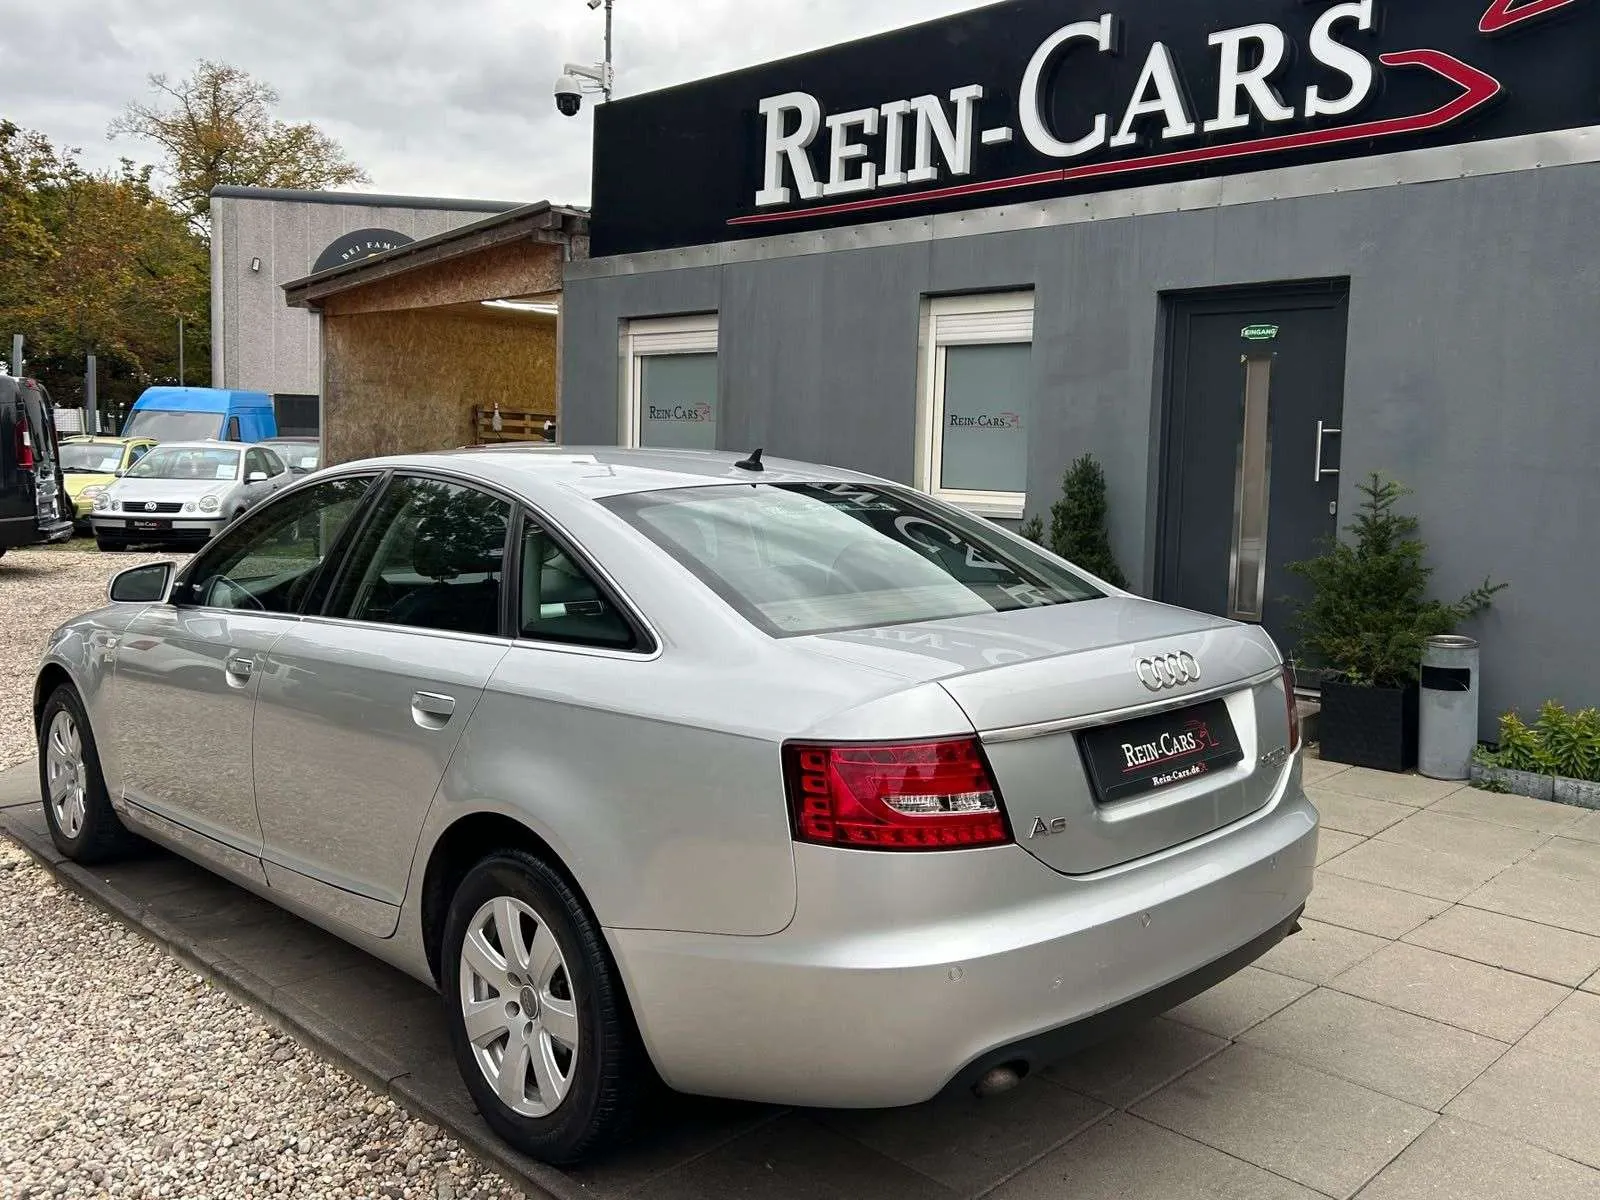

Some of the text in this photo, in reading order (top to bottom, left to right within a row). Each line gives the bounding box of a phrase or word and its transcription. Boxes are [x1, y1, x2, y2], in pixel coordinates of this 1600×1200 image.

[755, 0, 1374, 206] REIN-CARS
[1244, 328, 1276, 336] EINGANG
[649, 405, 698, 419] REIN-CARS
[950, 414, 1005, 427] REIN-CARS
[1121, 731, 1196, 767] REIN-CARS
[1152, 765, 1200, 786] Rein-Cars.de
[1029, 815, 1066, 839] A6
